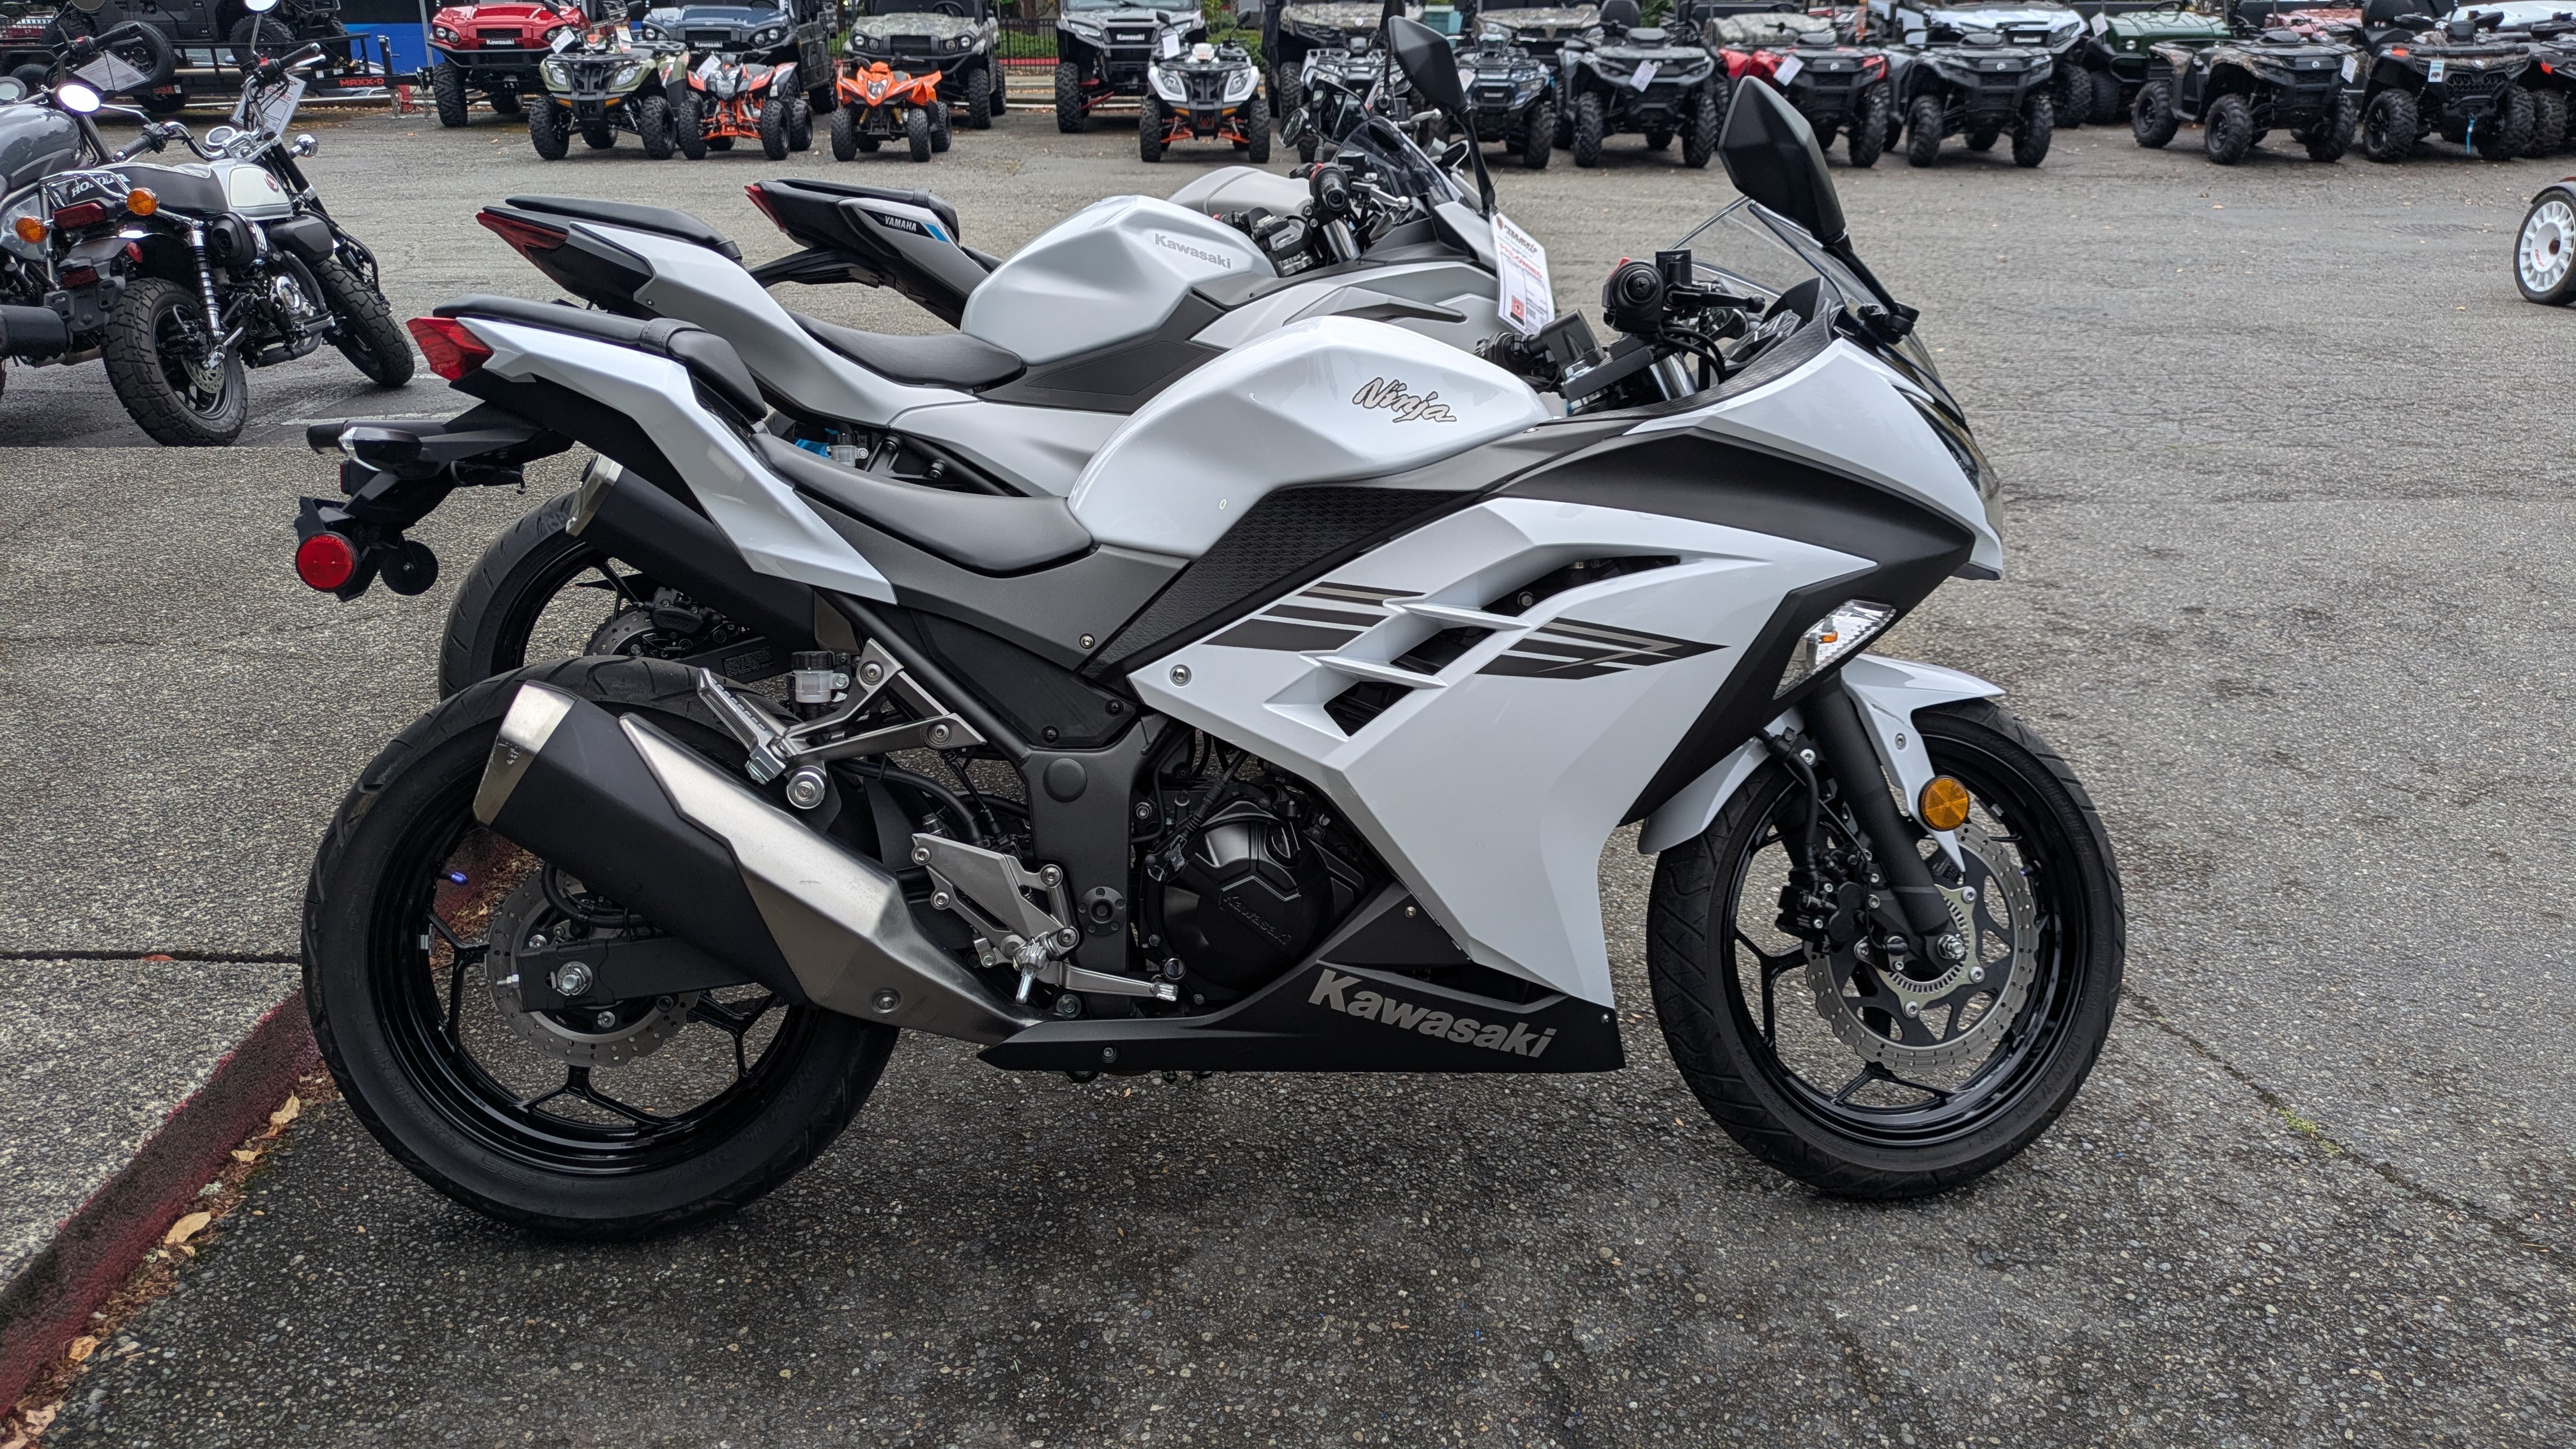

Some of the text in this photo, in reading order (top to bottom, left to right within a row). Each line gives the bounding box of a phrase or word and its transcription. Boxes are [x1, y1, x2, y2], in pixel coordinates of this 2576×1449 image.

[339, 78, 385, 87] MAXX-D
[885, 216, 917, 232] YAMAHA
[1155, 233, 1231, 270] Kawasaki
[1352, 377, 1457, 423] Ninja
[1223, 896, 1292, 946] Kawasaki
[1308, 969, 1558, 1058] Kawasaki
